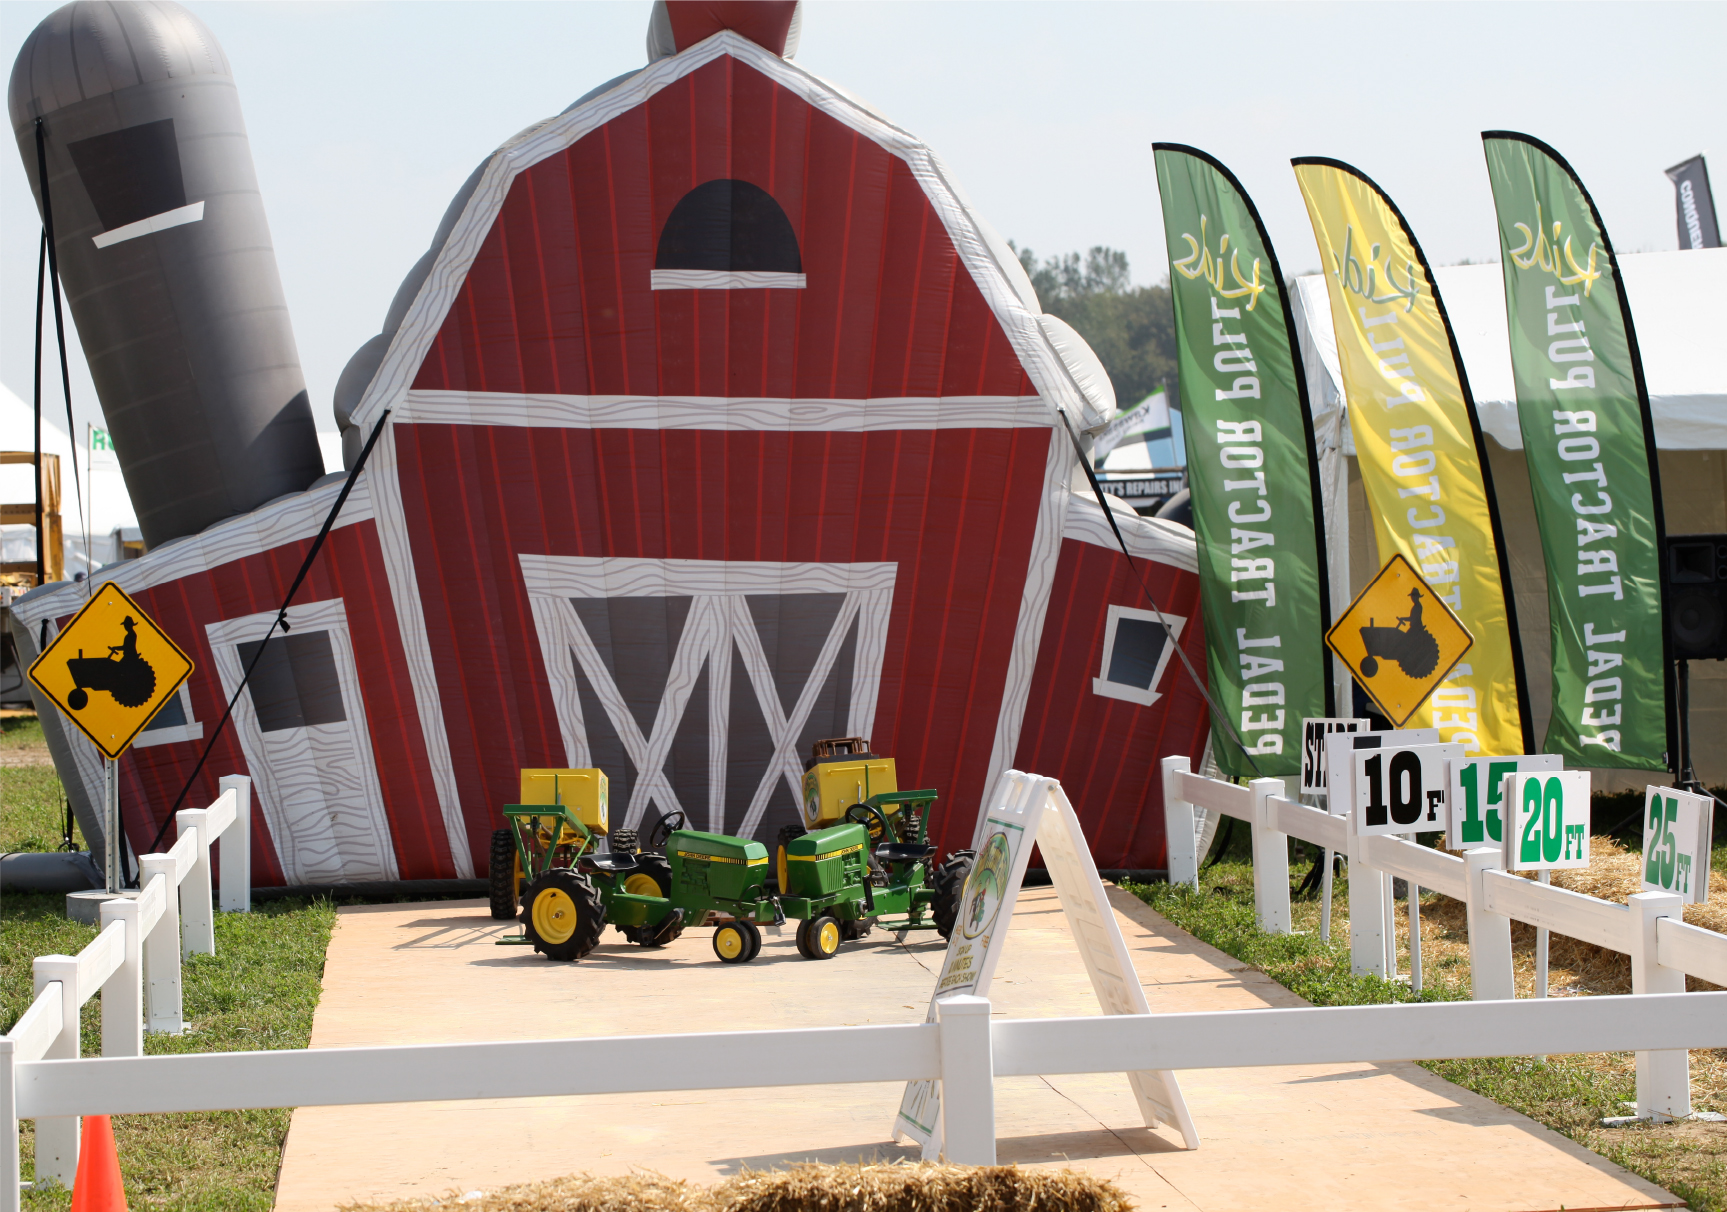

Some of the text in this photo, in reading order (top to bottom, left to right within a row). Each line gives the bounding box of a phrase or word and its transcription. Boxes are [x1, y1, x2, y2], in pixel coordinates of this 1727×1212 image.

[1126, 480, 1168, 496] REPAIRS
[1364, 750, 1423, 826] 10
[1426, 790, 1445, 822] F
[1459, 761, 1518, 843] 15
[1520, 777, 1585, 863] 20 FT
[1645, 792, 1692, 894] 25 FT
